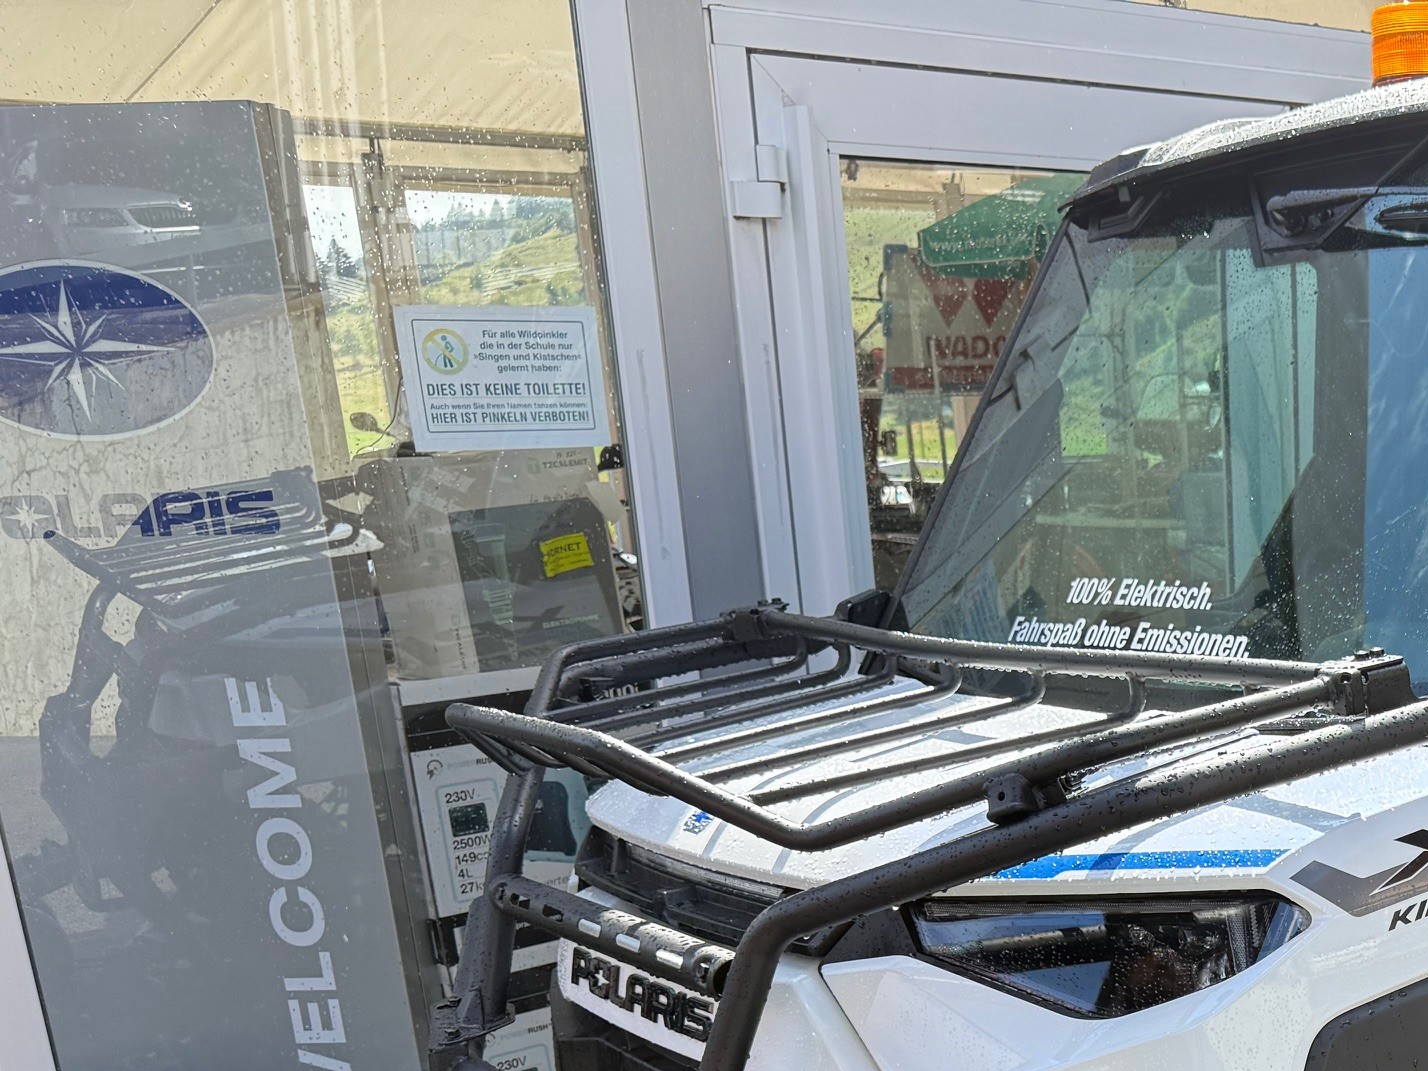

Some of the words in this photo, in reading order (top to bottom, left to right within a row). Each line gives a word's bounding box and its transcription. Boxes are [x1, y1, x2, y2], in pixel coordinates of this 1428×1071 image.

[482, 329, 497, 339] Für
[500, 330, 516, 339] alle
[479, 341, 494, 350] die
[496, 341, 505, 350] in
[507, 341, 522, 350] der
[524, 341, 556, 350] Schule
[513, 352, 530, 361] und
[497, 364, 529, 374] gelernt
[531, 364, 562, 373] haben:
[426, 383, 457, 396] DIES
[460, 383, 480, 396] IST
[484, 383, 522, 396] KEINE
[524, 382, 586, 396] TOILETTE!
[430, 402, 450, 411] Auch
[473, 402, 485, 410] Sie
[430, 412, 458, 425] HIER
[460, 412, 478, 424] IST
[481, 411, 528, 424] PINKELN
[531, 410, 590, 423] VERBOTEN!
[0, 488, 281, 540] OLARIS
[1066, 577, 1116, 606] 100%
[1113, 578, 1213, 611] Elektrisch.
[1007, 616, 1087, 648] Fahrspaß
[1083, 619, 1131, 649] ohne
[1130, 621, 1250, 659] Emissionen.
[445, 788, 476, 804] 230V
[452, 835, 492, 851] 2500W
[457, 866, 474, 879] 4L
[460, 879, 485, 894] 27k
[571, 946, 715, 1042] POLARIS
[497, 1055, 527, 1071] 230V
